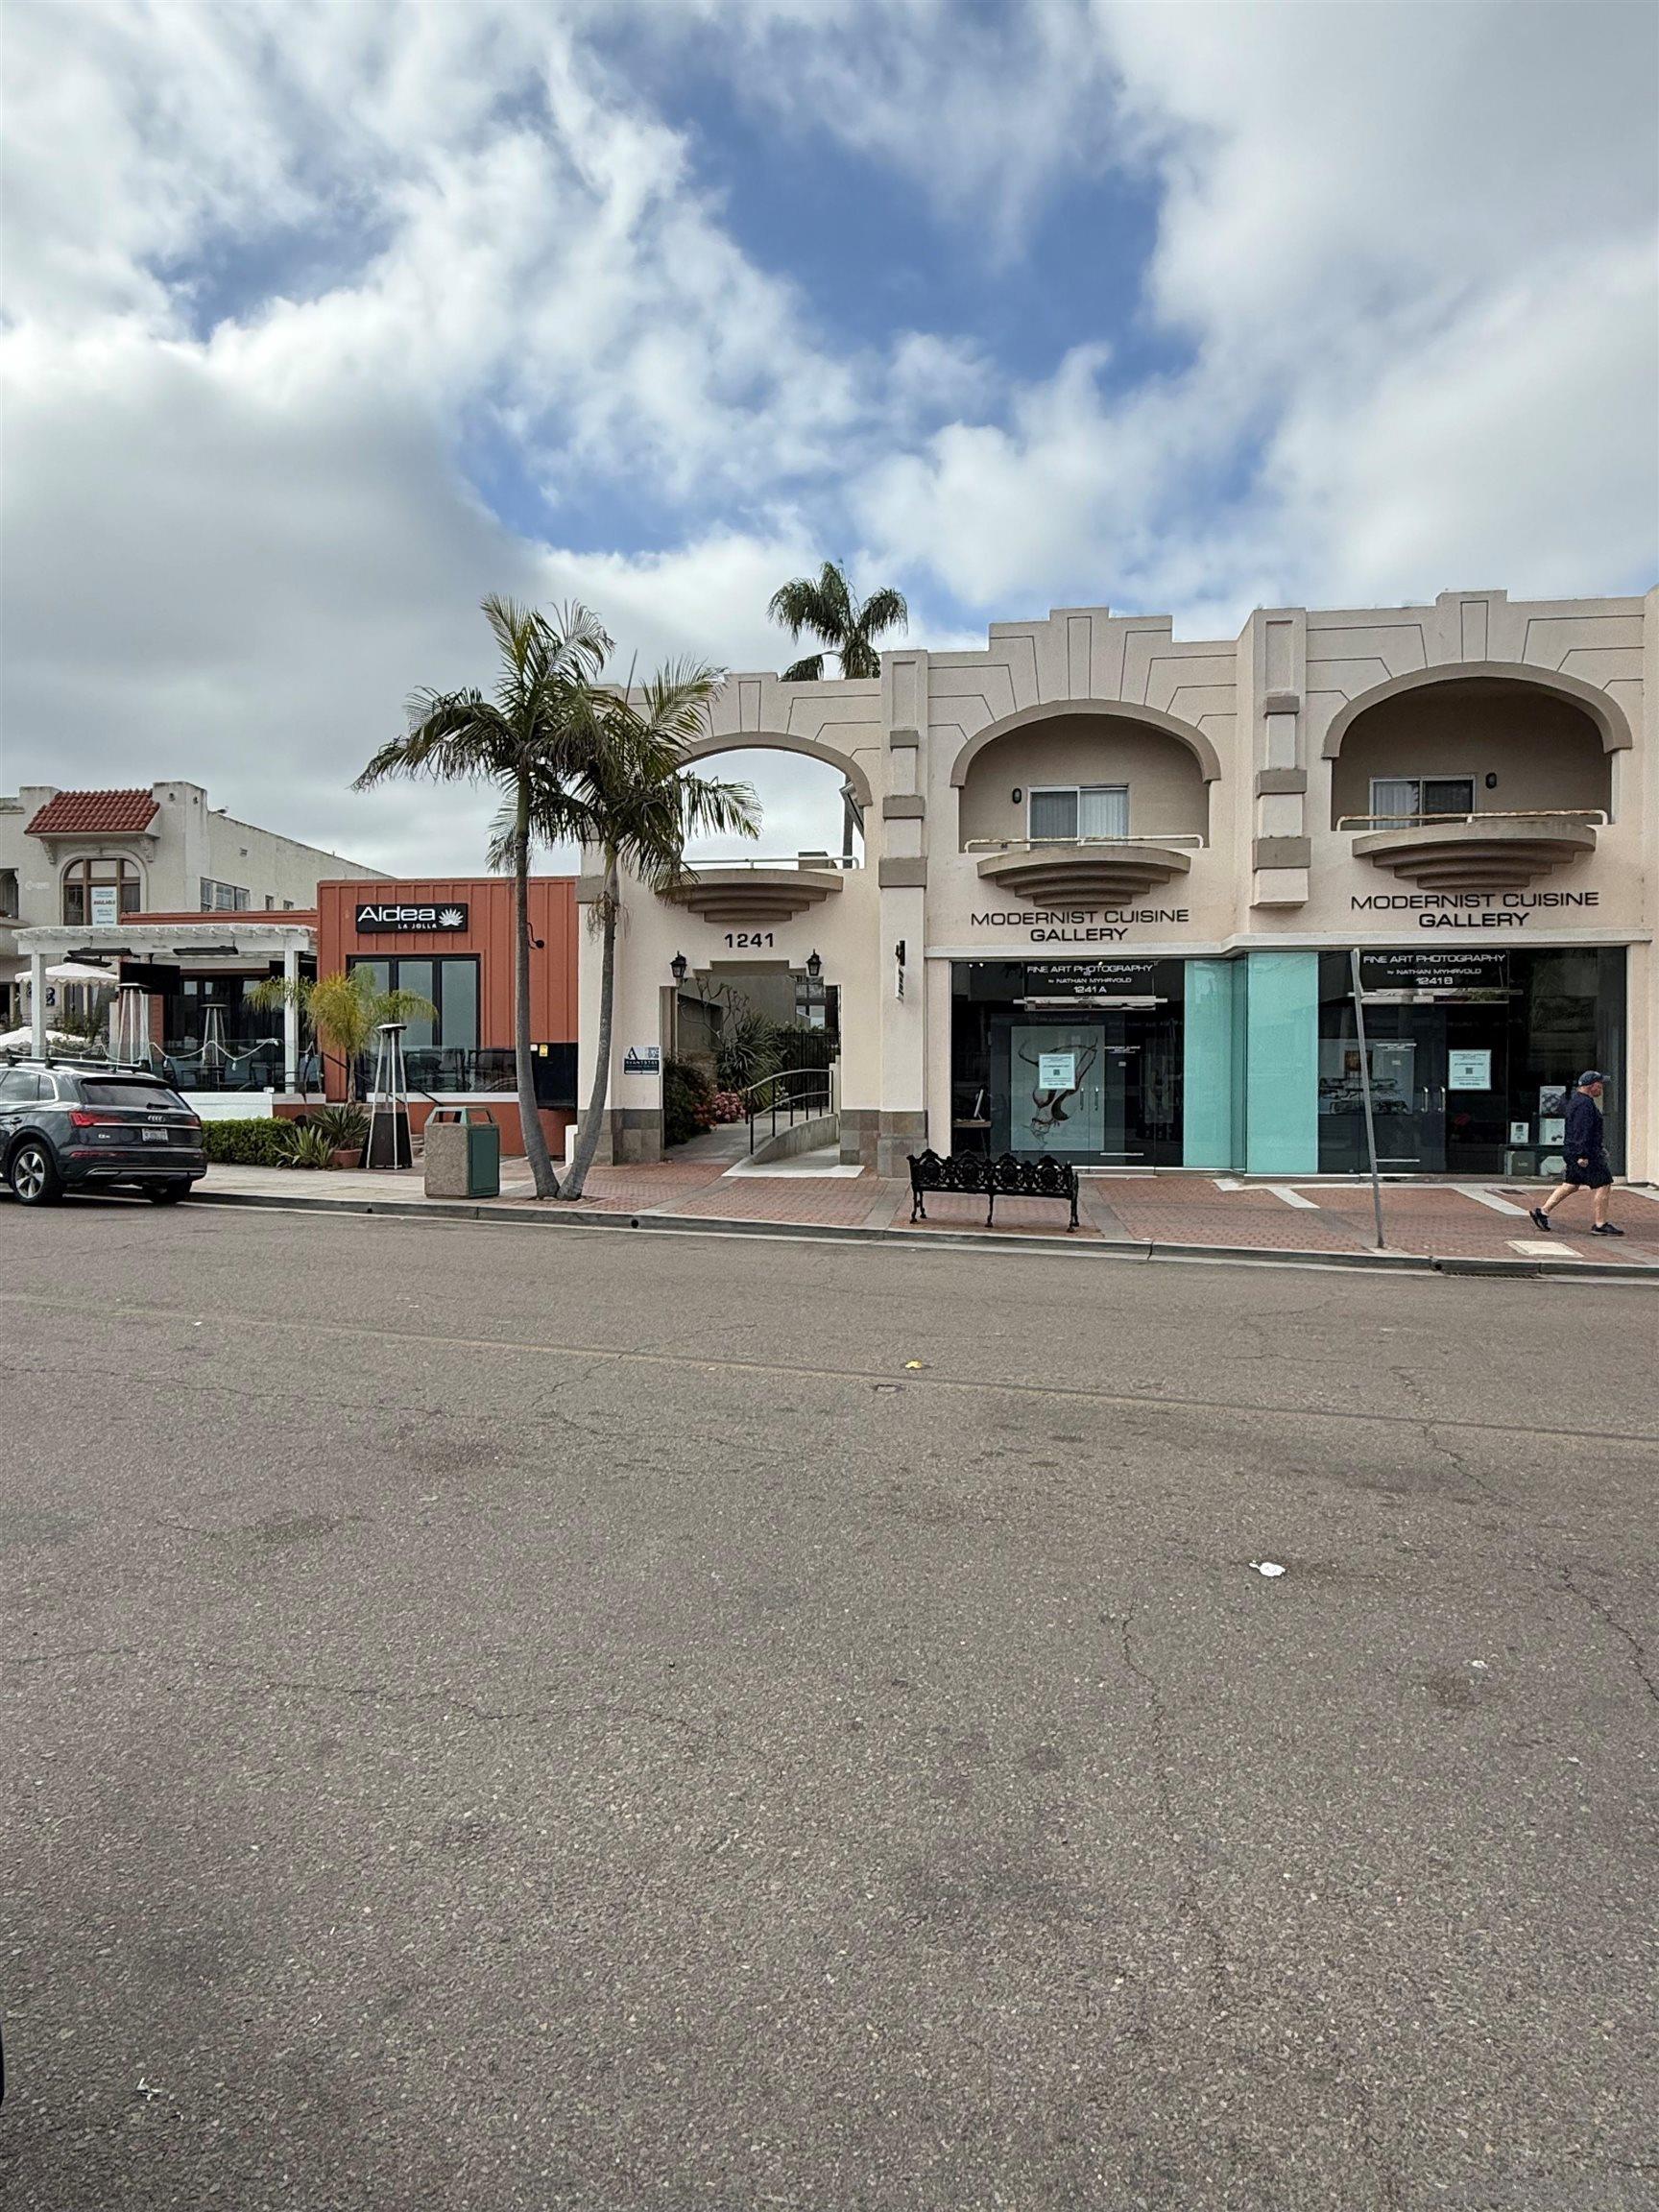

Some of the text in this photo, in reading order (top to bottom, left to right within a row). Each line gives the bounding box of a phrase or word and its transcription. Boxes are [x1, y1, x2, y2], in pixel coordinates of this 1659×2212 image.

[1351, 892, 1599, 910] MODERNIST CUISINE
[357, 905, 436, 923] Aldea
[971, 909, 1190, 926] MODERNIST CUISINE
[1418, 912, 1530, 928] GALLERY
[724, 932, 774, 949] 1241
[1030, 927, 1129, 942] GALLERY
[1363, 955, 1387, 964] FINE
[1415, 954, 1506, 963] PHOTOGRAPHY
[1026, 965, 1048, 974] FINE
[1073, 964, 1153, 973] PHOTOGRAPHY
[1415, 976, 1442, 985] 1241
[1073, 985, 1107, 994] 1241 A
